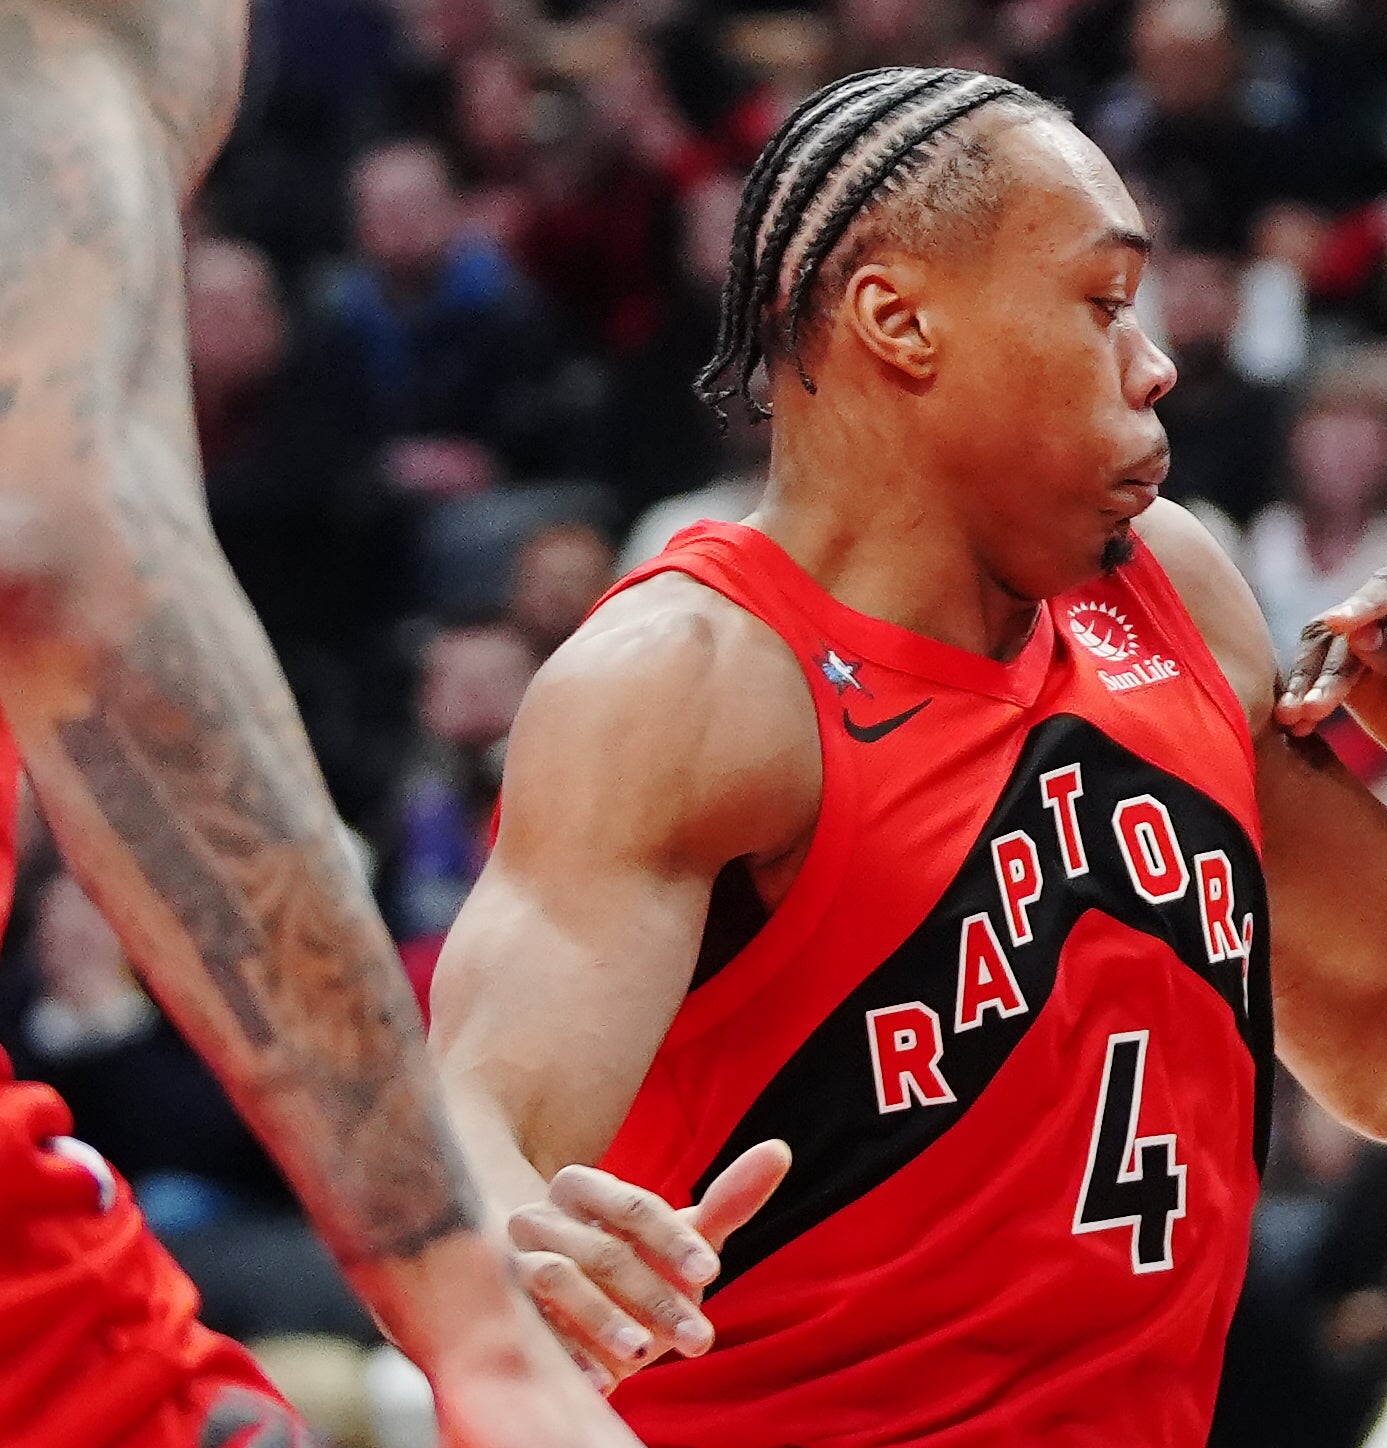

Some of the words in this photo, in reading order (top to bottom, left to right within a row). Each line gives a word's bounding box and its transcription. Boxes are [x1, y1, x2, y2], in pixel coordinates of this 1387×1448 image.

[1096, 668, 1143, 692] Sun
[1132, 654, 1180, 685] Life
[866, 763, 1254, 1116] RAPTOR
[1072, 1029, 1188, 1275] 4
